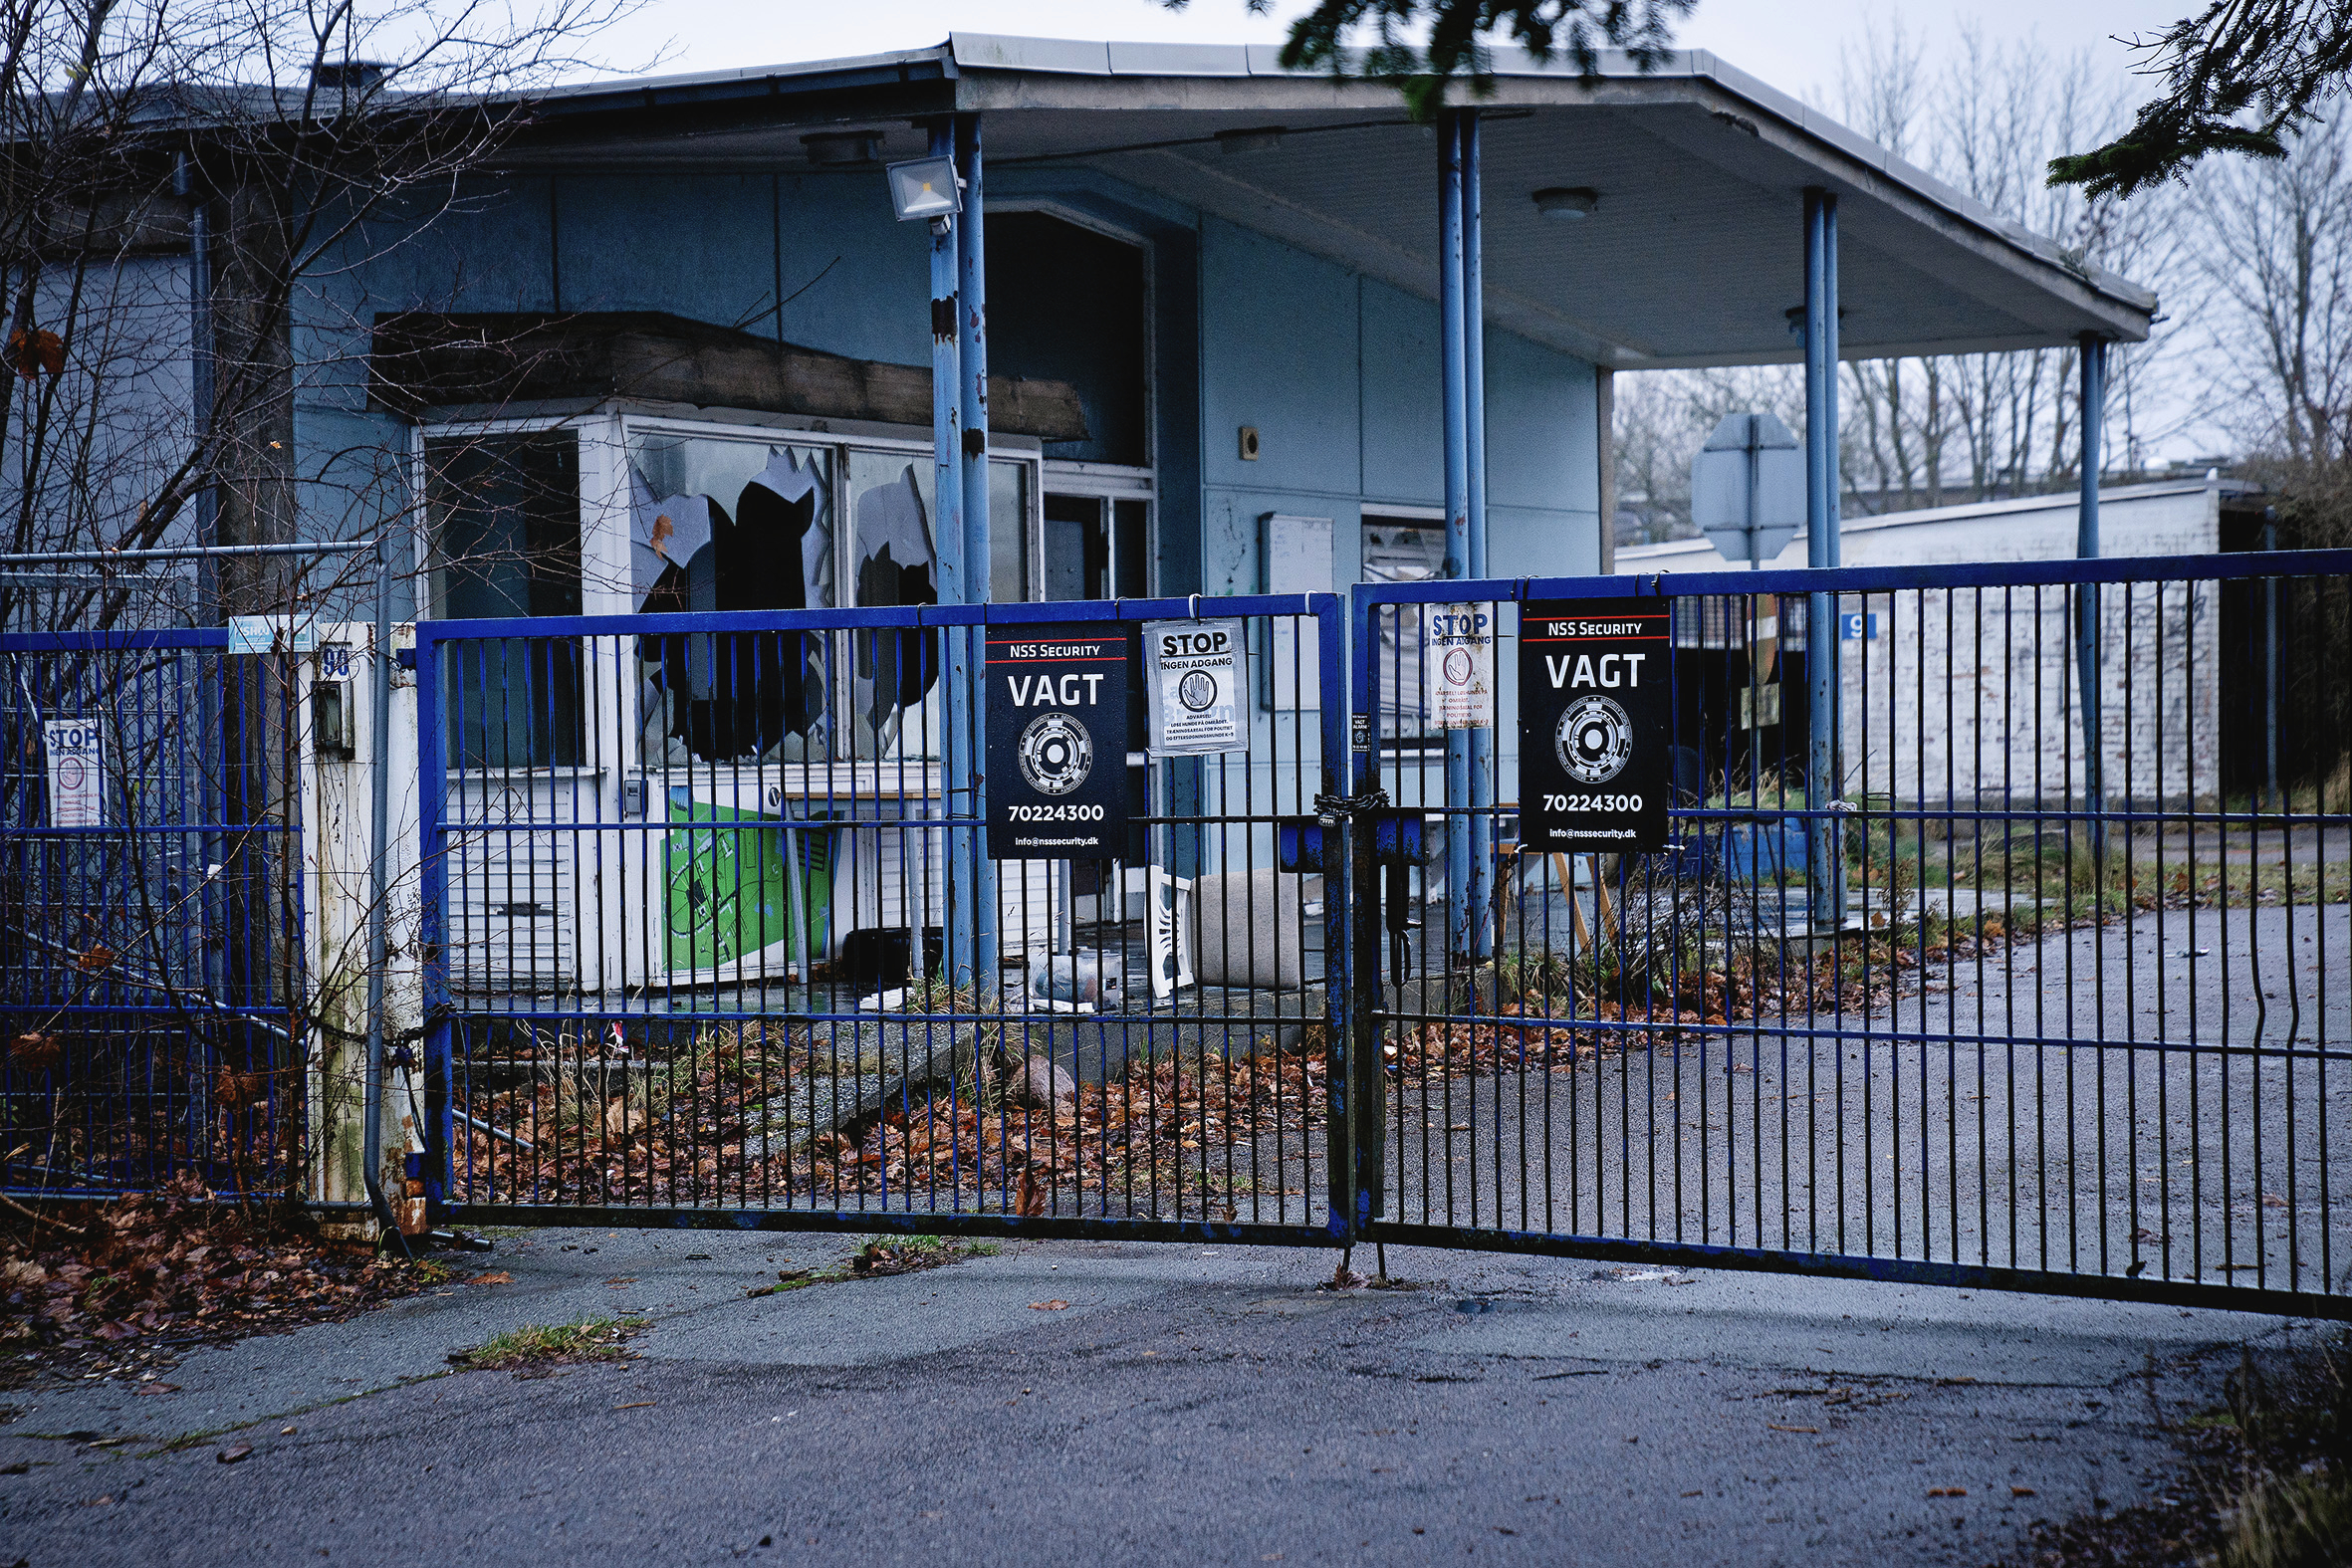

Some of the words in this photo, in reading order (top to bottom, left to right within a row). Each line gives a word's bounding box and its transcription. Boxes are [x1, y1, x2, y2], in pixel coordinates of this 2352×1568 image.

[1433, 613, 1488, 636] STOP
[1548, 622, 1576, 636] NSS
[1010, 644, 1037, 658] NSS
[1163, 632, 1228, 655] STOP
[1160, 660, 1189, 670] INGEN
[1190, 657, 1233, 668] ADGANG
[1544, 653, 1646, 689] VAGT
[1007, 673, 1104, 707] VAGT
[49, 728, 99, 747] STOP
[1542, 793, 1643, 812] 70224300
[1008, 803, 1104, 821] 70224300
[1015, 837, 1099, 847] info@nsssecurity.dk
[1549, 828, 1637, 839] info@nsssecurity.dk
